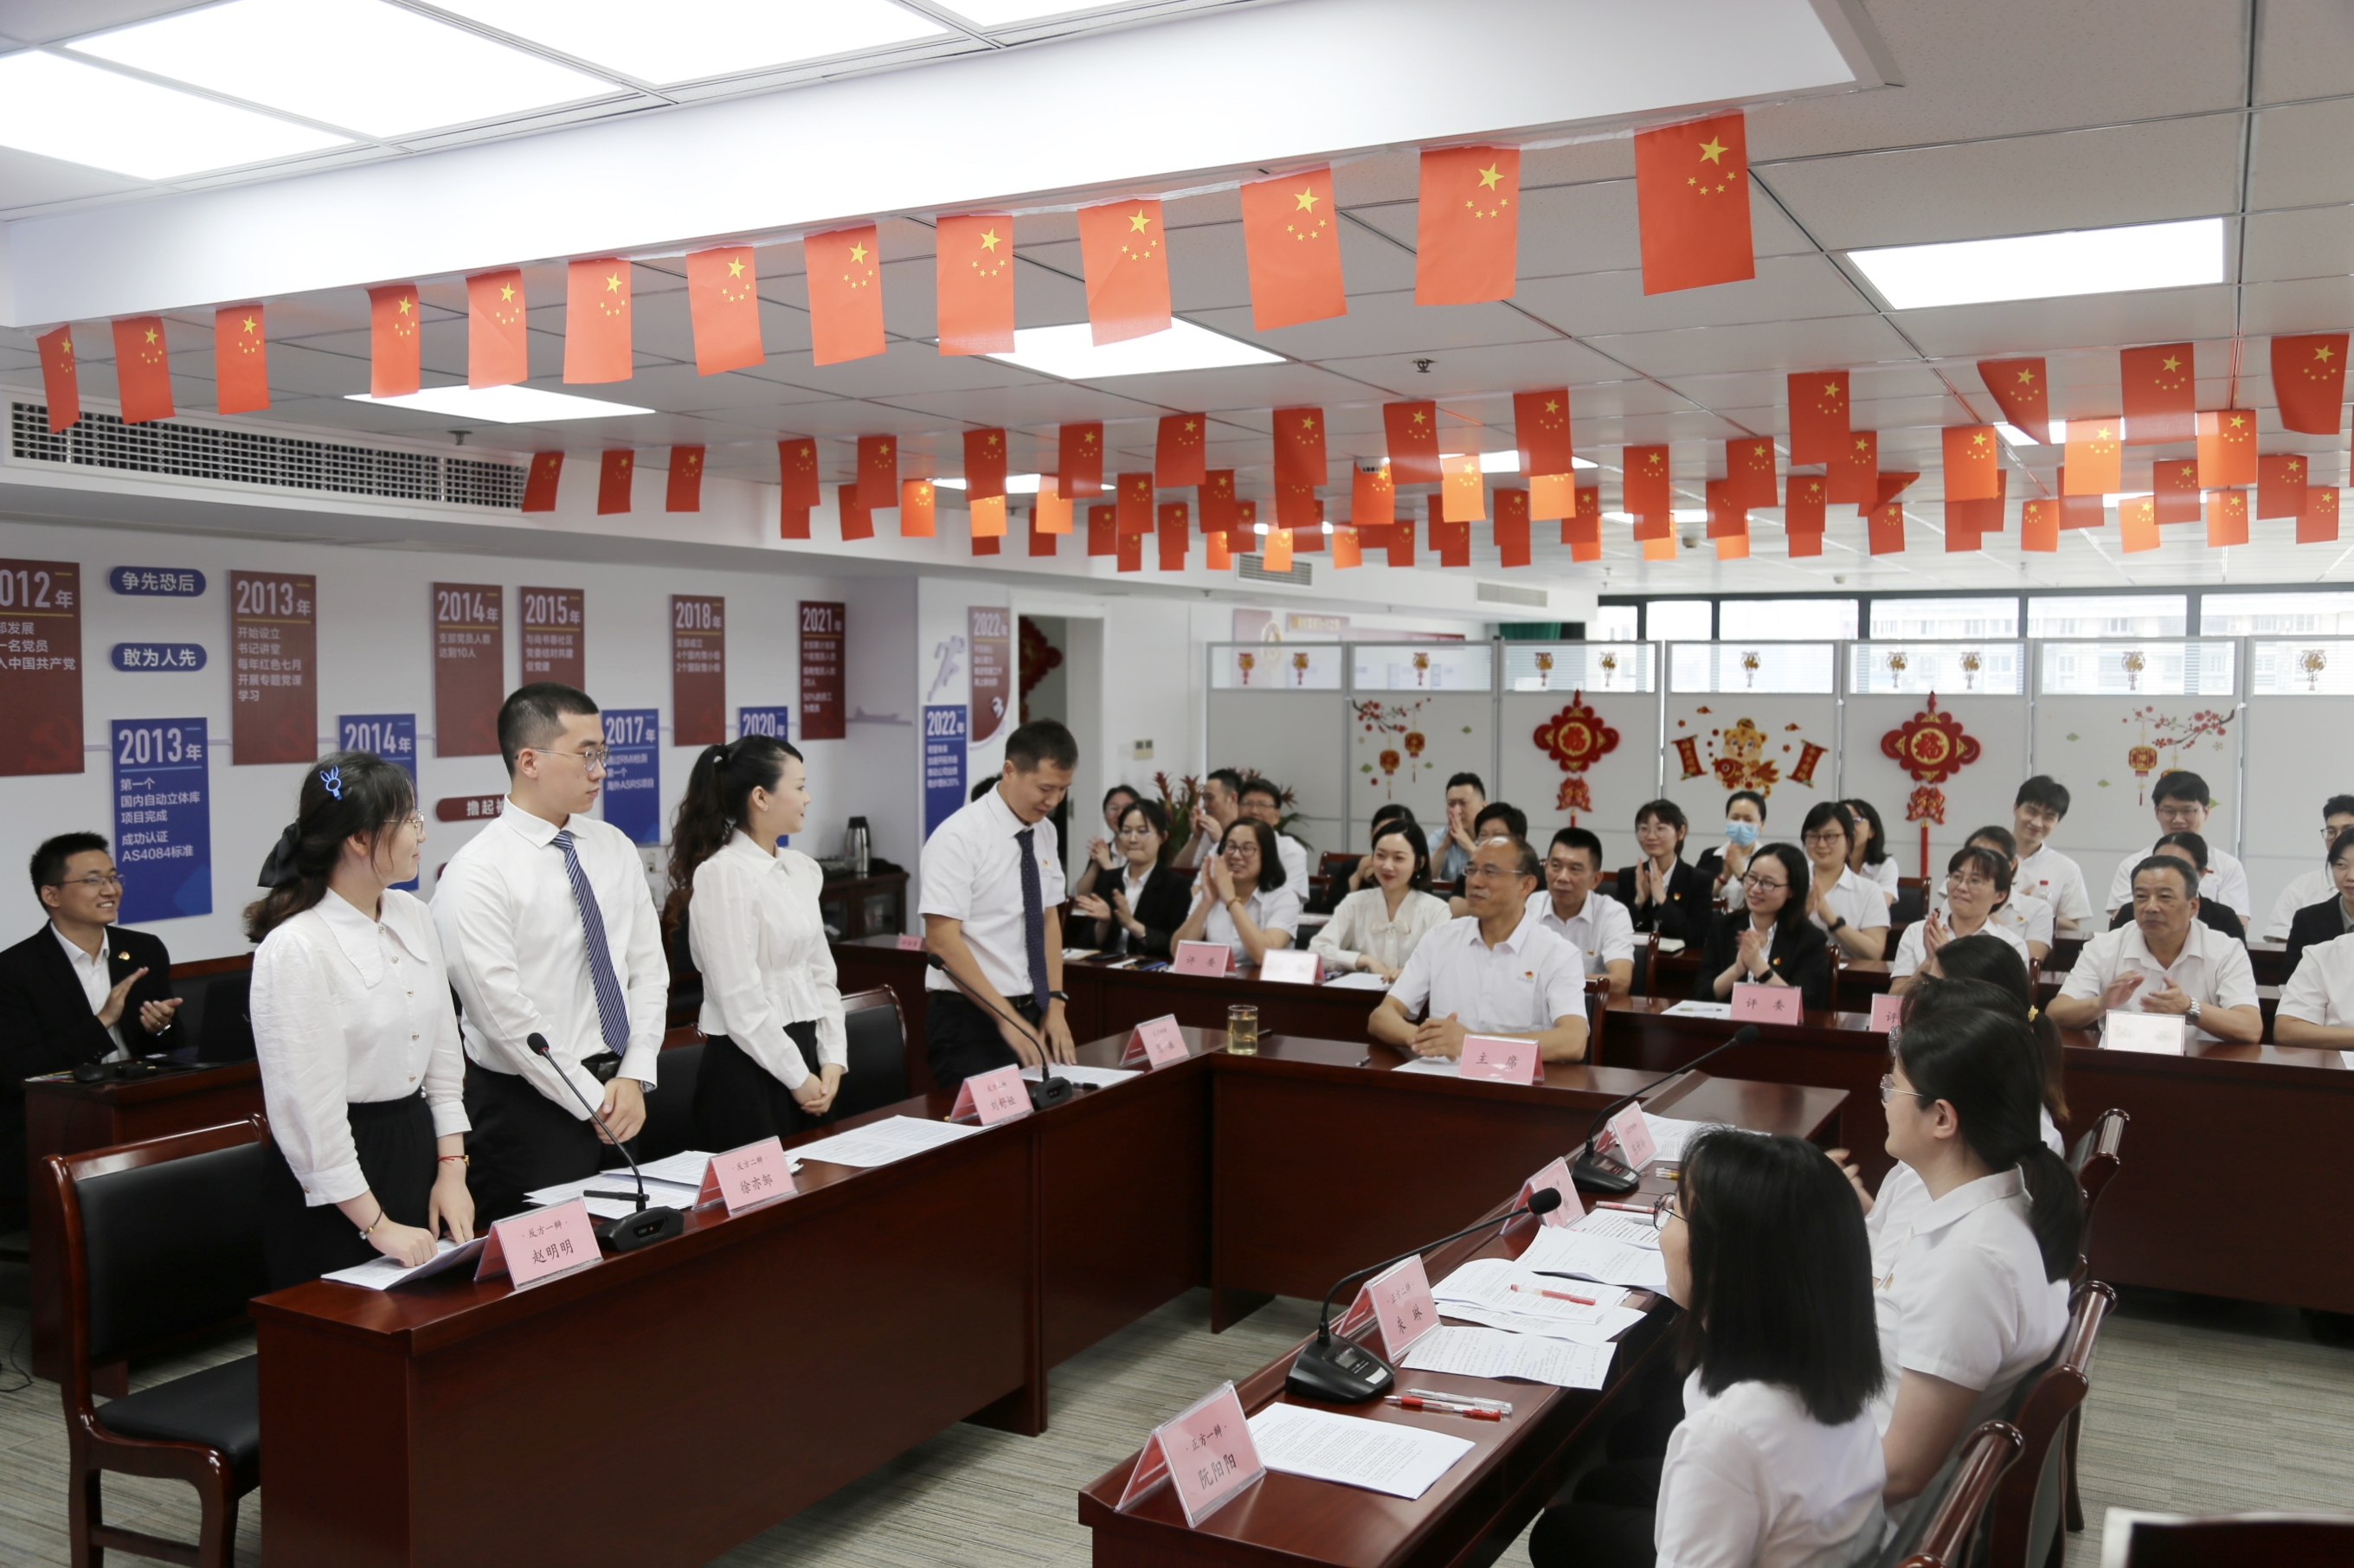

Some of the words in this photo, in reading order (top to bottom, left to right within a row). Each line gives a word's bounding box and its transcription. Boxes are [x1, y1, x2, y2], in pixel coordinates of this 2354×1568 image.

[122, 571, 195, 592] 争先恐后
[236, 580, 311, 616] 2013年
[438, 591, 498, 622] 2014年
[524, 594, 581, 625] 2015年
[675, 601, 722, 629] 2018年
[802, 607, 842, 633] 2021年
[237, 627, 280, 639] 开始设立
[974, 612, 1007, 637] 2022年
[123, 648, 196, 667] 敢为人先
[237, 642, 280, 655] 书记讲堂
[237, 658, 301, 672] 每年红色七月
[237, 674, 302, 686] 开展专题党课
[238, 690, 260, 702] 学习
[606, 716, 656, 745] 2017年
[743, 713, 786, 737] 2020年
[927, 710, 965, 736] 2022年
[119, 727, 203, 764] 2013年
[345, 723, 412, 754] 2014年
[1914, 731, 1945, 760] 福
[120, 777, 155, 791] 第一个
[120, 791, 200, 808] 国内自动立体库
[121, 809, 168, 825] 项目完成
[122, 831, 168, 846] 成功认证
[122, 845, 194, 862] AS4084标准
[1746, 998, 1785, 1011] 评委
[1476, 1052, 1519, 1070] 主席
[736, 1155, 763, 1171] 反方二辩
[529, 1219, 563, 1239] 反方一辩
[532, 1238, 574, 1265] 赵明明
[1391, 1282, 1412, 1304] 正方二辩
[1191, 1423, 1223, 1452] 正方一辩
[1197, 1453, 1237, 1490] 阮阳阳
